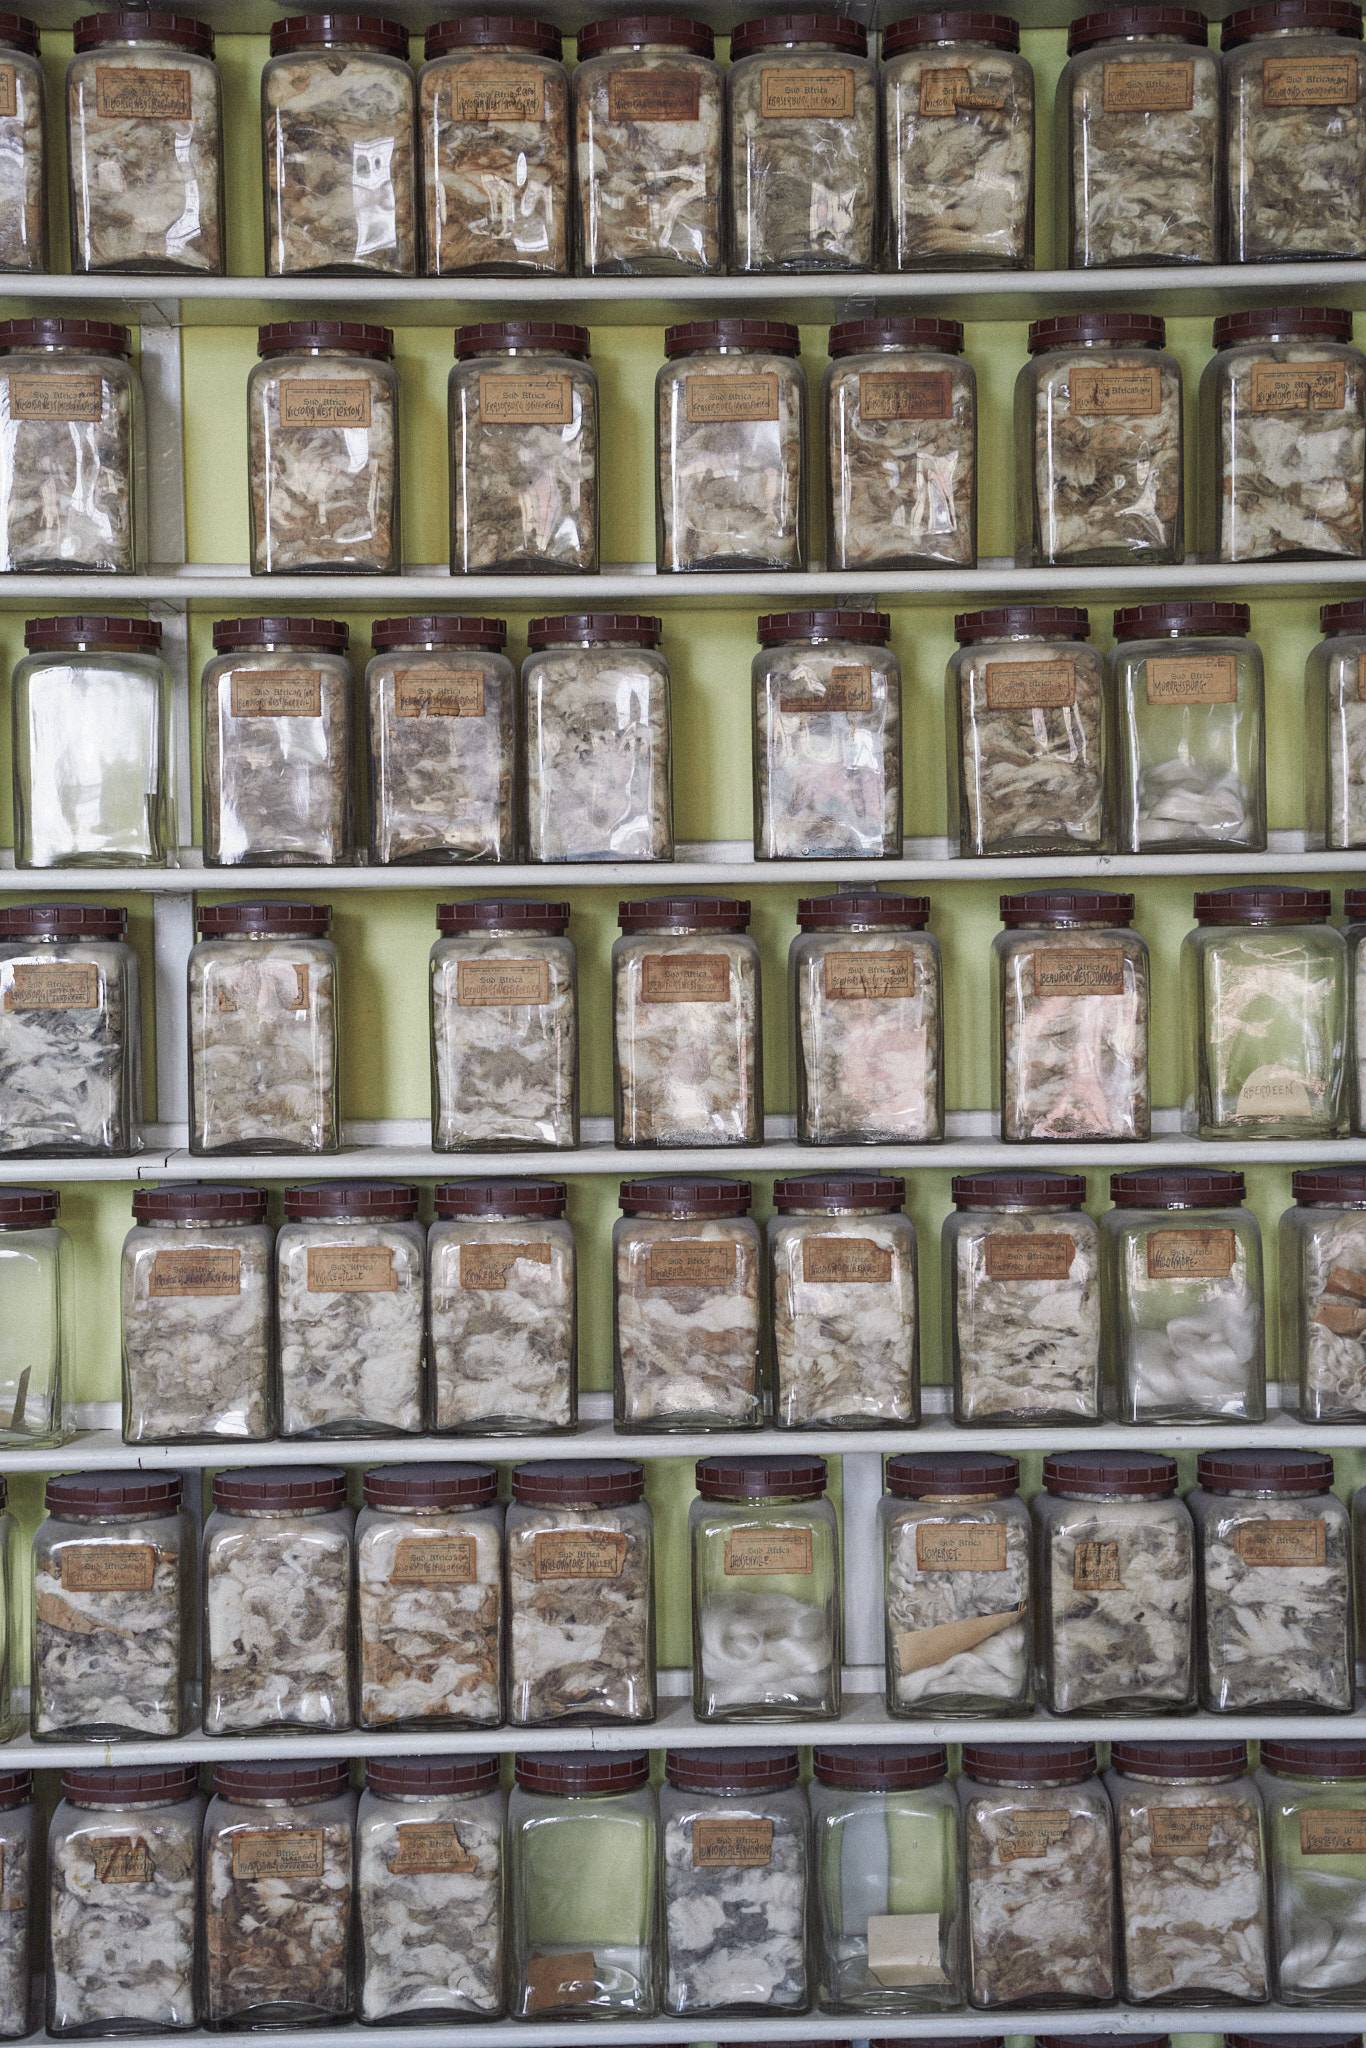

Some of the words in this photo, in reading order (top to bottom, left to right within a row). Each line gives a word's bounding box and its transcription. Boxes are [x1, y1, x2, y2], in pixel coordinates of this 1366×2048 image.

[503, 391, 519, 399] Sud
[522, 391, 546, 399] Africa
[302, 398, 319, 406] Sud
[323, 398, 346, 406] Africa
[316, 404, 331, 418] WEST
[1190, 672, 1214, 680] Africa
[480, 976, 496, 984] Sud
[499, 976, 523, 984] Africa
[577, 1551, 600, 1559] Africa
